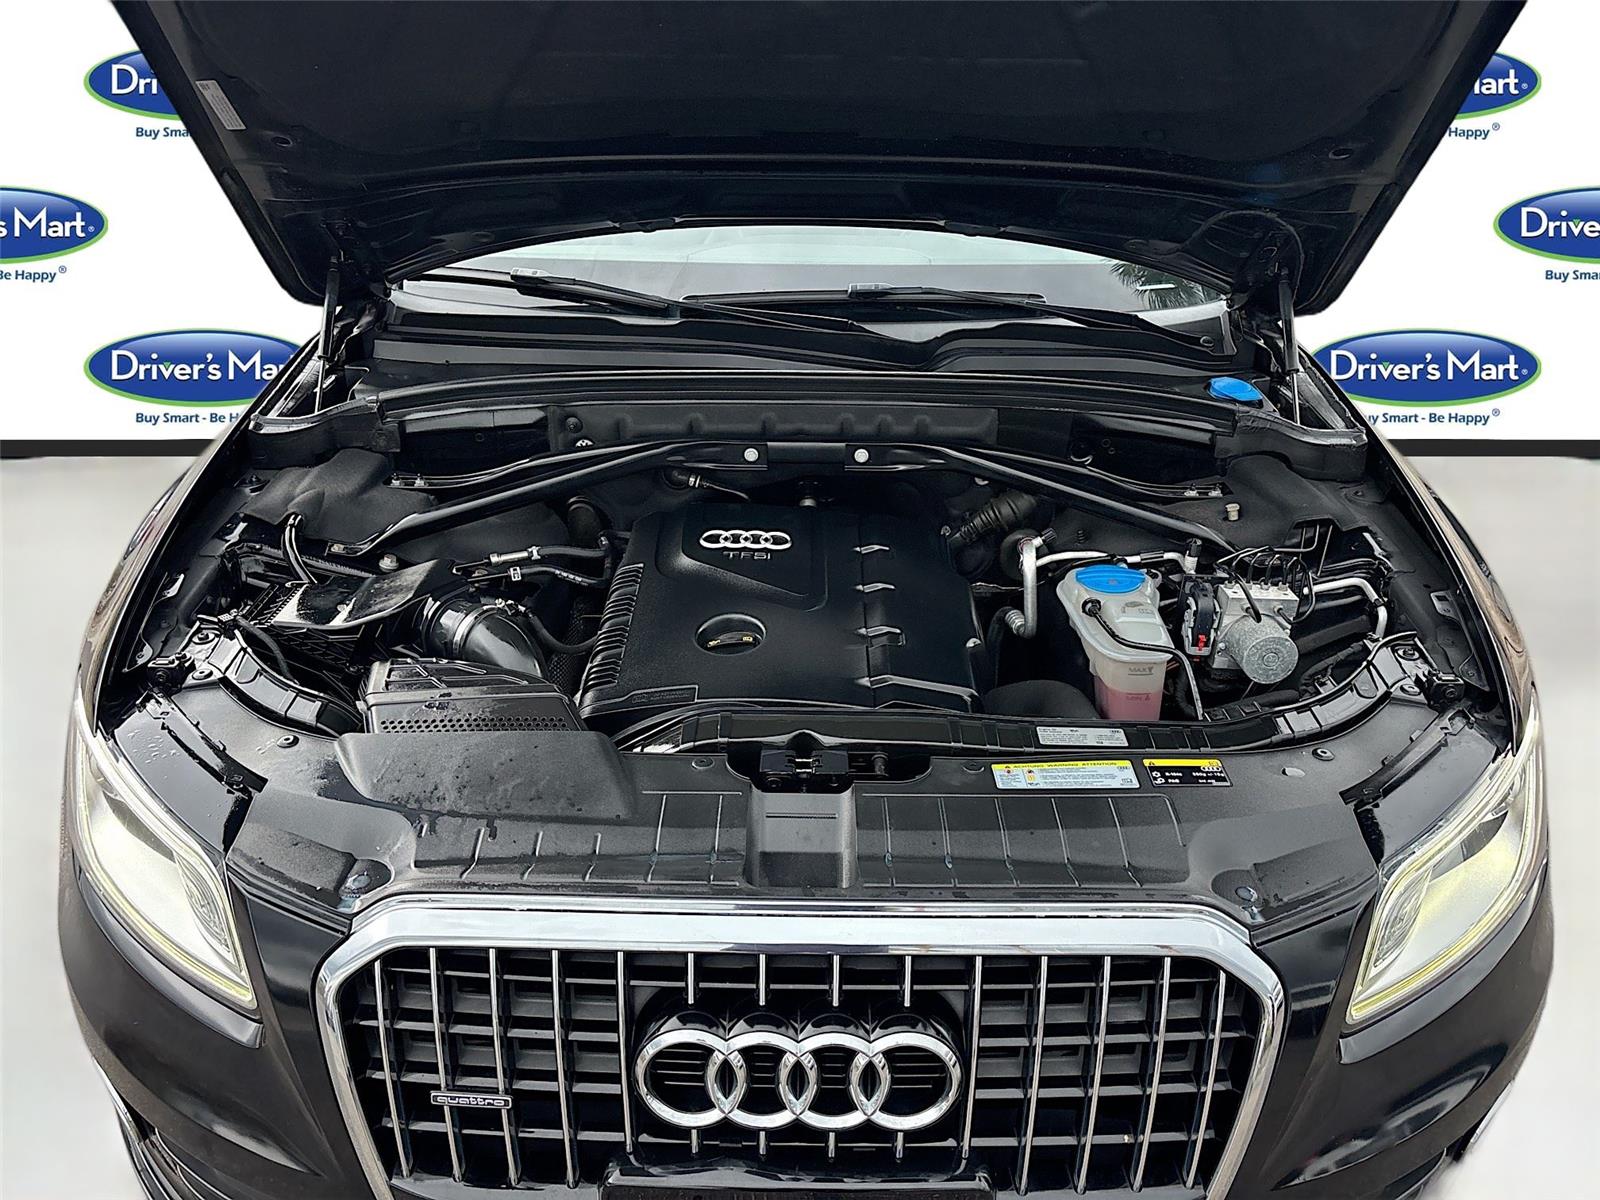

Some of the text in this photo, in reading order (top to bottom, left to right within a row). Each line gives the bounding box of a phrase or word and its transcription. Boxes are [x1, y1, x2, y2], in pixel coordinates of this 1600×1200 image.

[1474, 68, 1519, 94] art
[136, 127, 190, 140] Buy Sma
[1447, 127, 1490, 140] Happy
[14, 207, 86, 237] Mart
[1521, 207, 1600, 238] Drive
[15, 270, 57, 283] Happy
[1545, 270, 1600, 283] Buy Sma
[111, 349, 286, 381] Driver's Ma
[1330, 349, 1519, 381] Driver's Mart
[136, 412, 160, 425] Buy
[163, 412, 200, 423] Smart
[209, 412, 226, 423] Be
[1382, 412, 1419, 423] Smart
[1429, 412, 1445, 423] Be
[1448, 412, 1490, 426] Happy
[722, 551, 771, 560] TFSI
[436, 1096, 506, 1107] quattro
